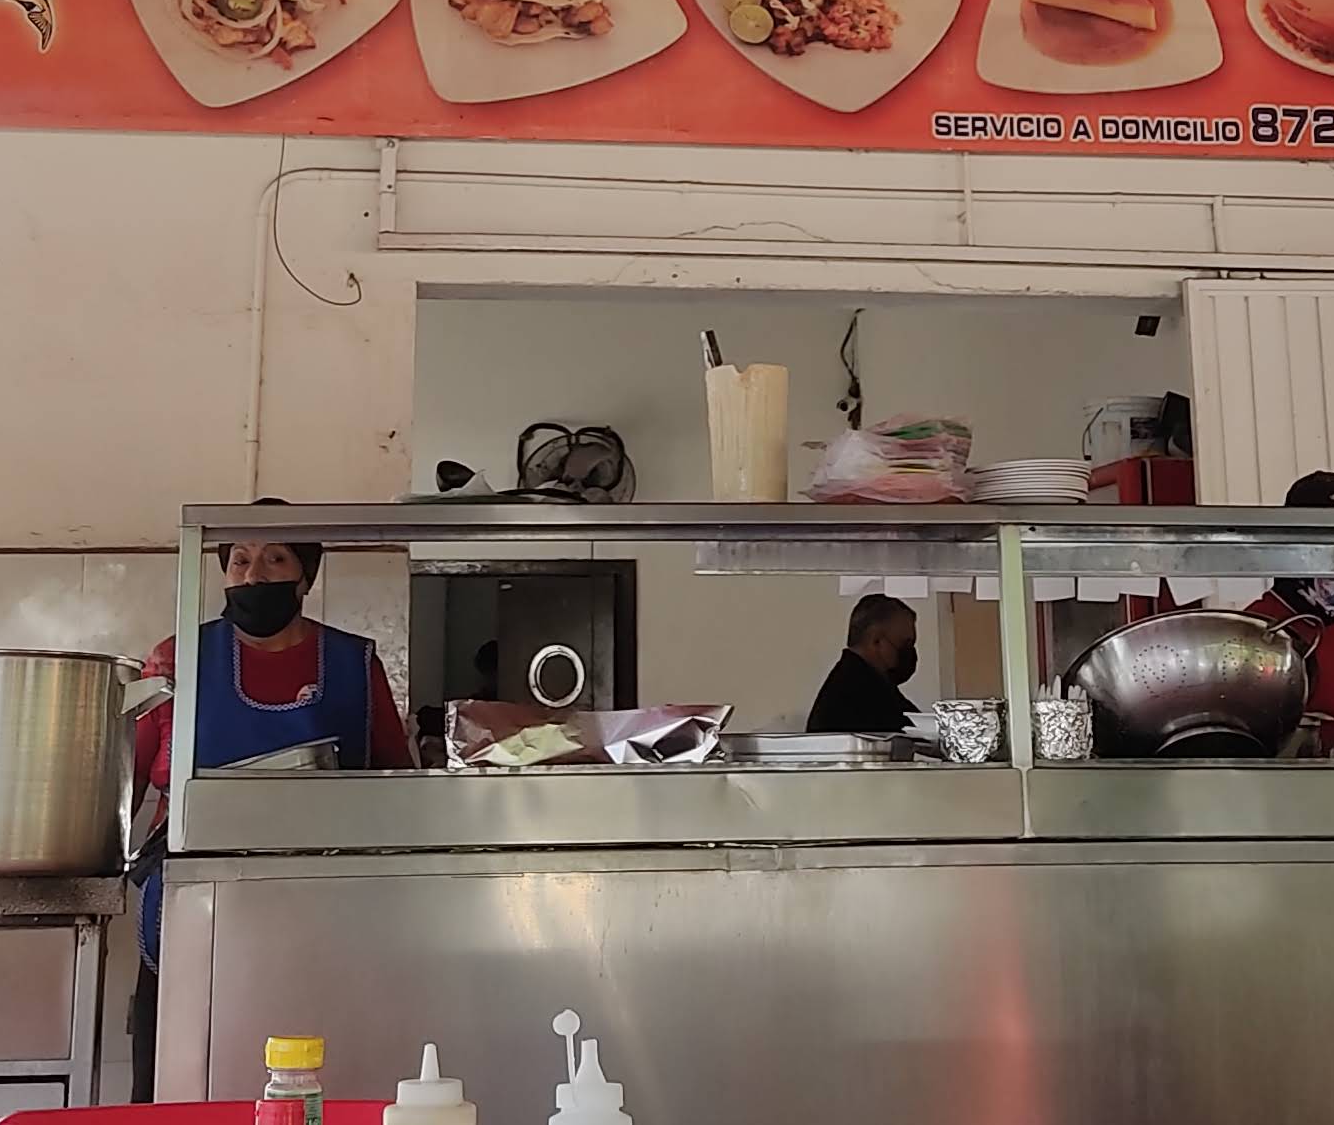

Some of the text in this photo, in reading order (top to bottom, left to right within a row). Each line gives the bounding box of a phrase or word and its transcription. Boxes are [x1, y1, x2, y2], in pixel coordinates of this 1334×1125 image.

[934, 113, 1062, 141] SERVICIO
[1072, 118, 1092, 141] A
[1100, 117, 1240, 143] DOMICILIO
